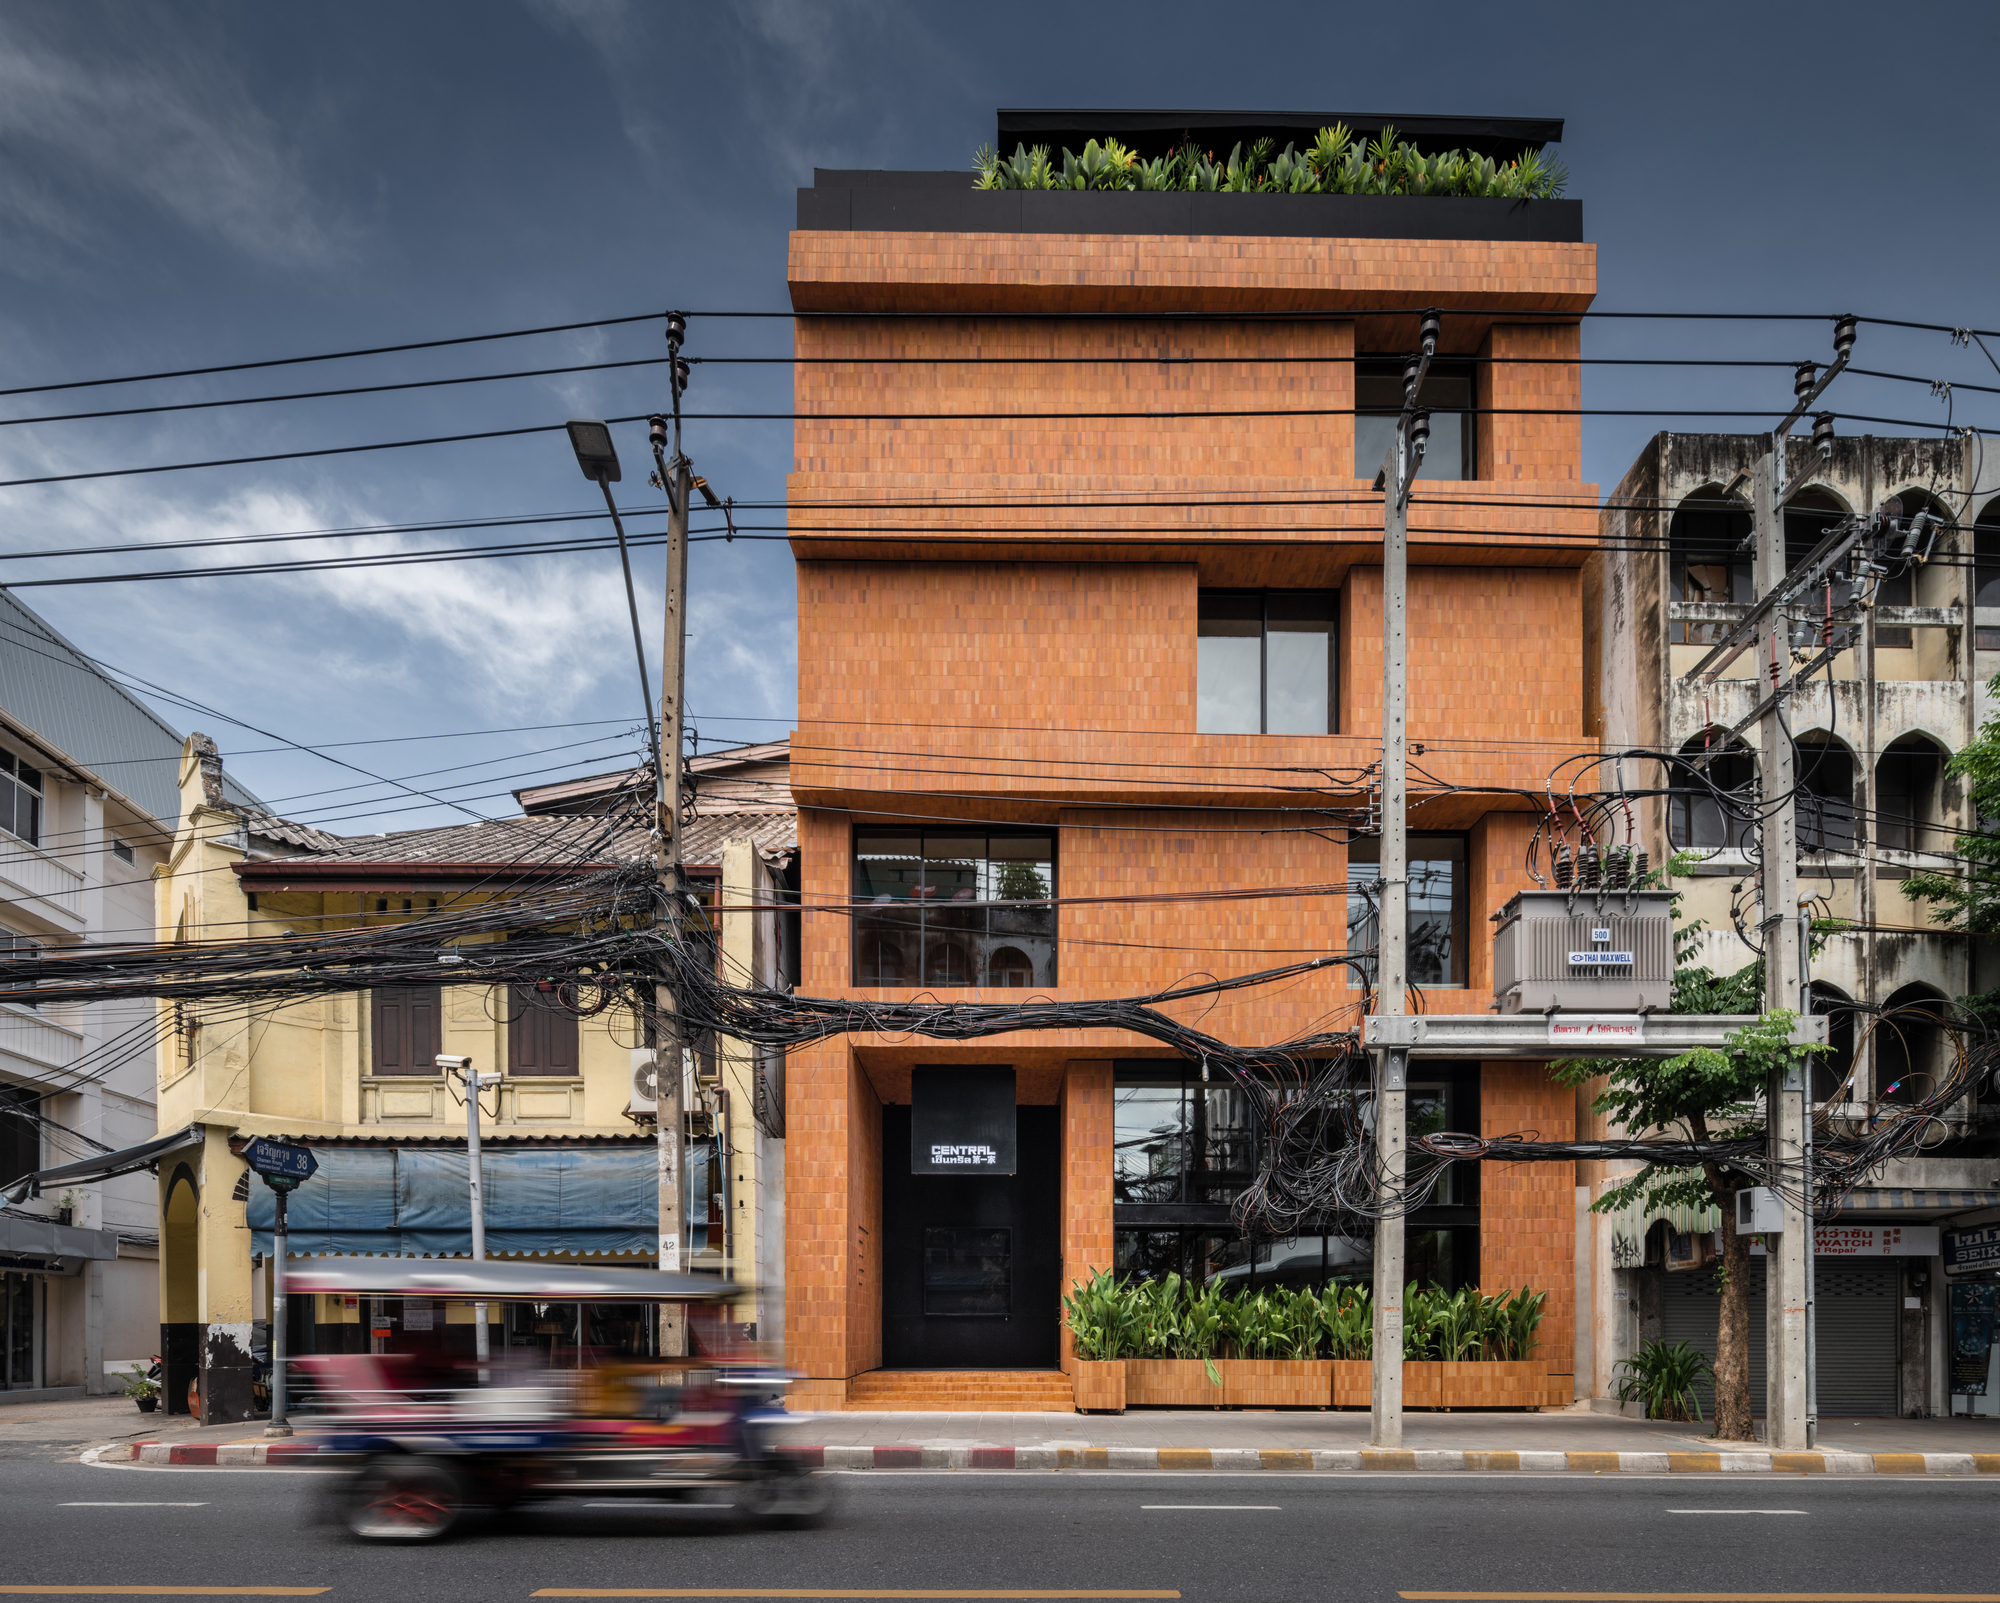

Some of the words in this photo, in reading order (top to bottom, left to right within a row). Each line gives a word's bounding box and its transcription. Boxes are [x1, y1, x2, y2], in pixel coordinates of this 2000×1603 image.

[1594, 930, 1608, 939] 500
[1584, 953, 1599, 962] THAI
[1600, 953, 1631, 962] MAXWELL
[1553, 1024, 1581, 1034] อันตราย
[256, 1143, 290, 1163] เจริญกรุง
[931, 1145, 996, 1155] CENTRAL
[296, 1154, 308, 1170] 38
[662, 1240, 675, 1250] 42
[1815, 1239, 1873, 1247] WATCH
